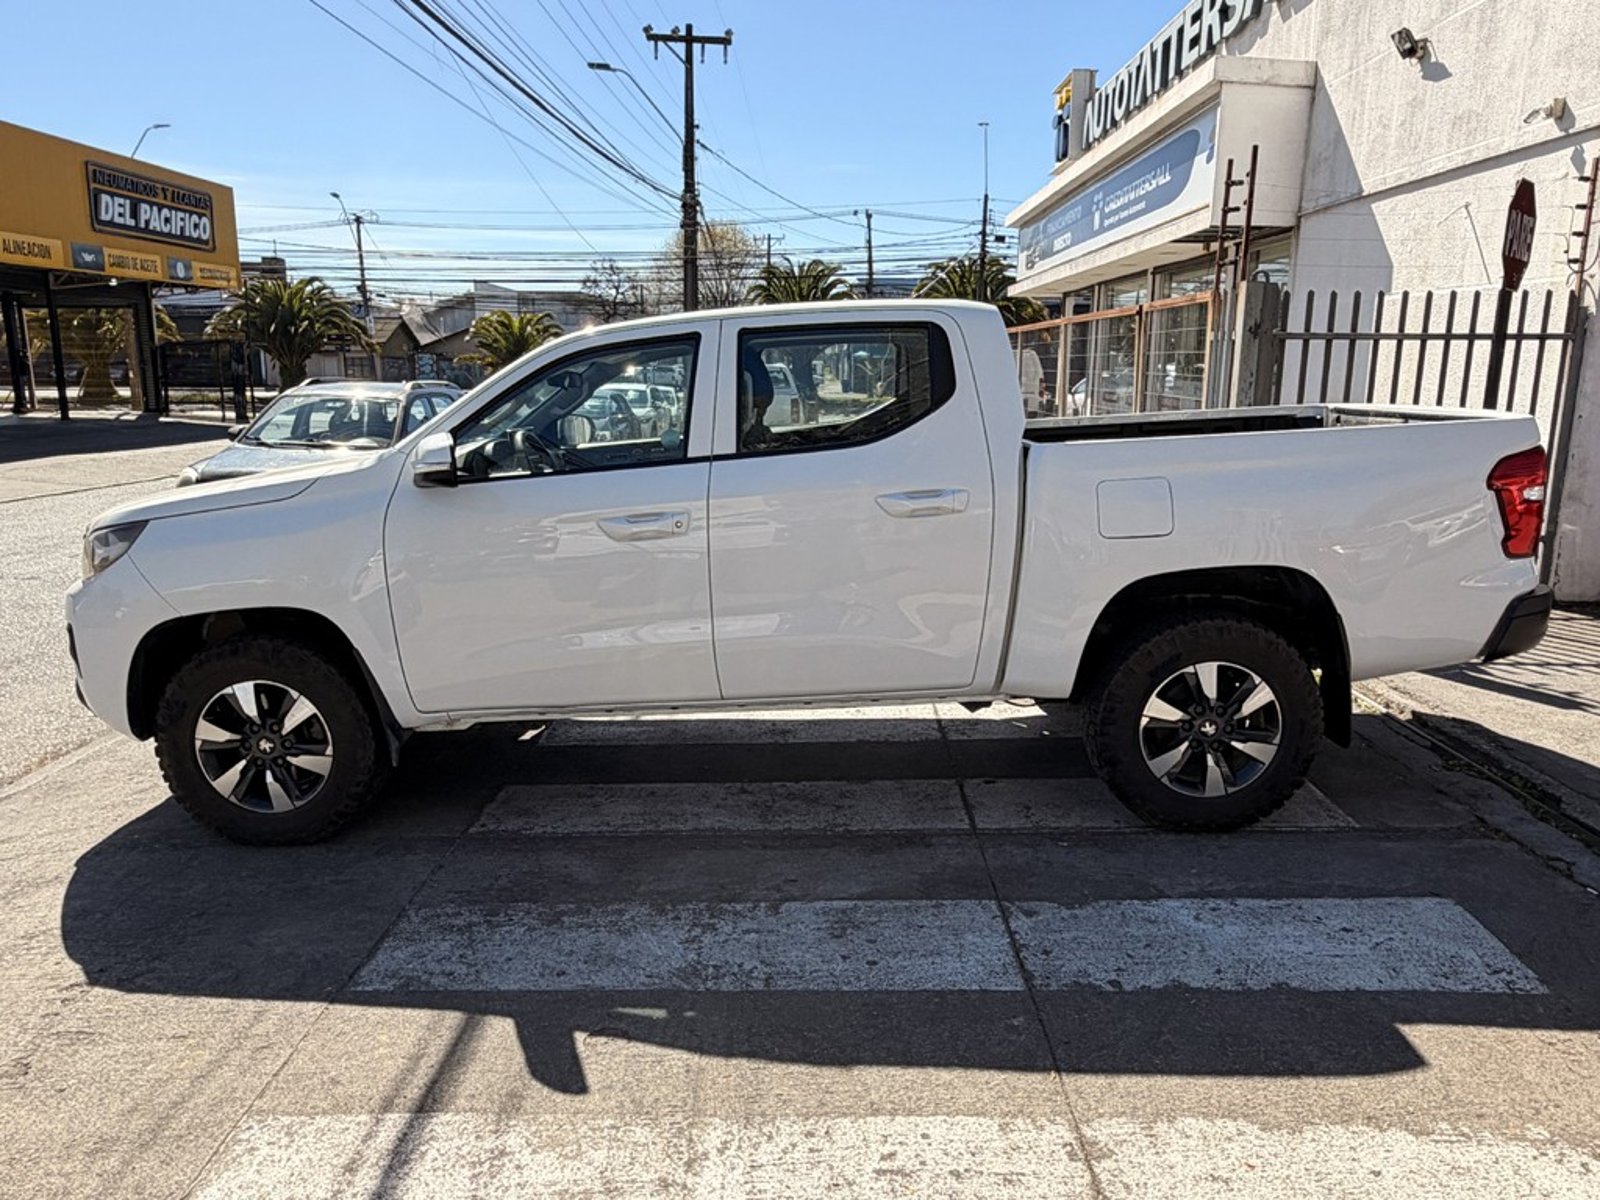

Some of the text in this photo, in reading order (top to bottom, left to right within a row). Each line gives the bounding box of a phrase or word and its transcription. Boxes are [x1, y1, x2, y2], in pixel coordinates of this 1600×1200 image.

[93, 168, 211, 209] NEUMATICOS Y LLANTAS
[99, 193, 211, 240] DEL PACIFICO
[1504, 208, 1536, 262] PARE
[2, 238, 53, 260] ALINEACION
[131, 256, 139, 272] DE
